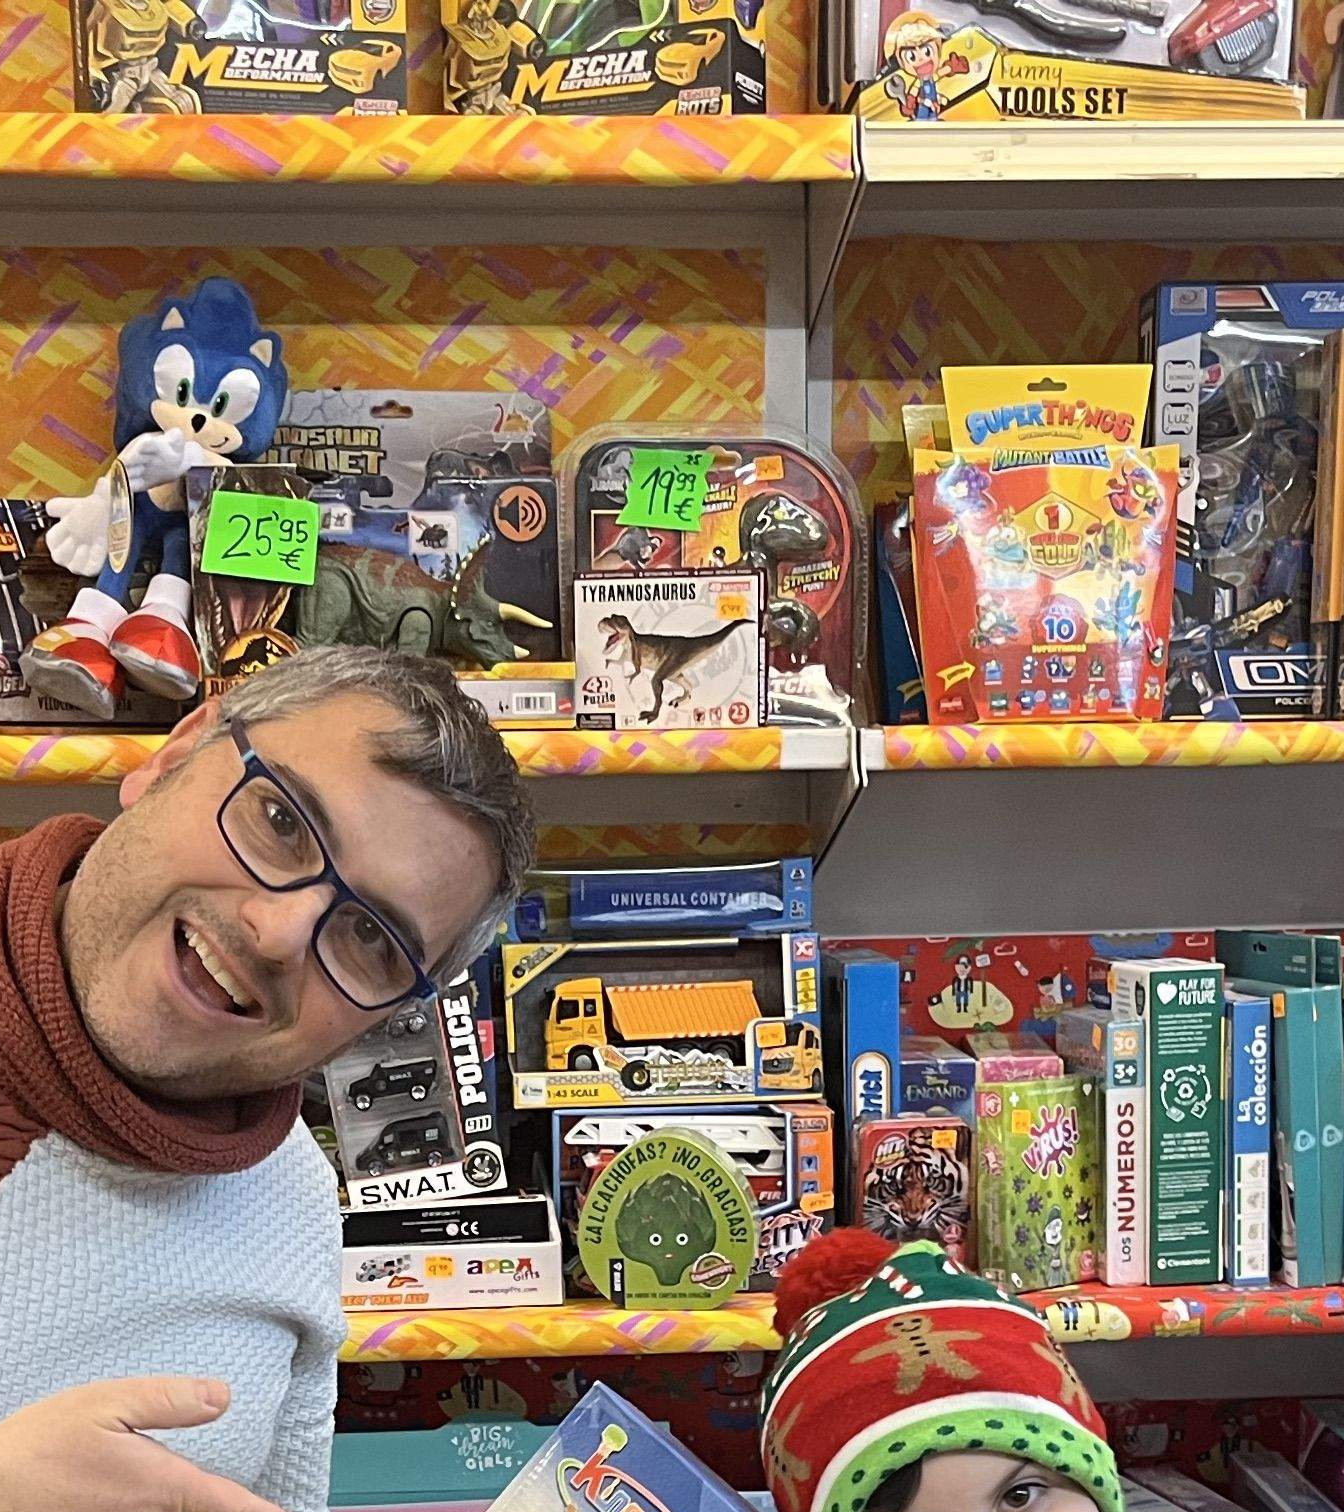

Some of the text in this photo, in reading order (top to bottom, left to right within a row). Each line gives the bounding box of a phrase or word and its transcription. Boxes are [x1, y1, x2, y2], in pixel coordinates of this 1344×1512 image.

[169, 42, 320, 89] MECHA
[224, 67, 325, 84] DEFORMATION
[518, 50, 650, 101] MECHA
[561, 71, 652, 91] DEFORMATION
[1000, 86, 1129, 117] TOOLS SET
[1168, 412, 1190, 425] LUZ
[992, 448, 1051, 469] MUTANT
[674, 498, 692, 522] €
[221, 509, 309, 571] 25'95 €
[581, 582, 697, 603] TYRANNOSAURUS
[1044, 616, 1076, 642] 10
[582, 694, 616, 706] Puzzle
[611, 891, 688, 907] UNIVERSAL
[442, 994, 487, 1107] POLICE
[1113, 1035, 1137, 1052] 30
[1113, 1063, 1137, 1081] 3+
[570, 1087, 600, 1100] SCALE
[360, 1170, 457, 1206] S.W.A.T.
[1112, 1101, 1136, 1263] LOS NÚMEROS
[583, 1139, 668, 1247] ¿ALCACHOFAS?
[470, 1424, 503, 1443] BIG
